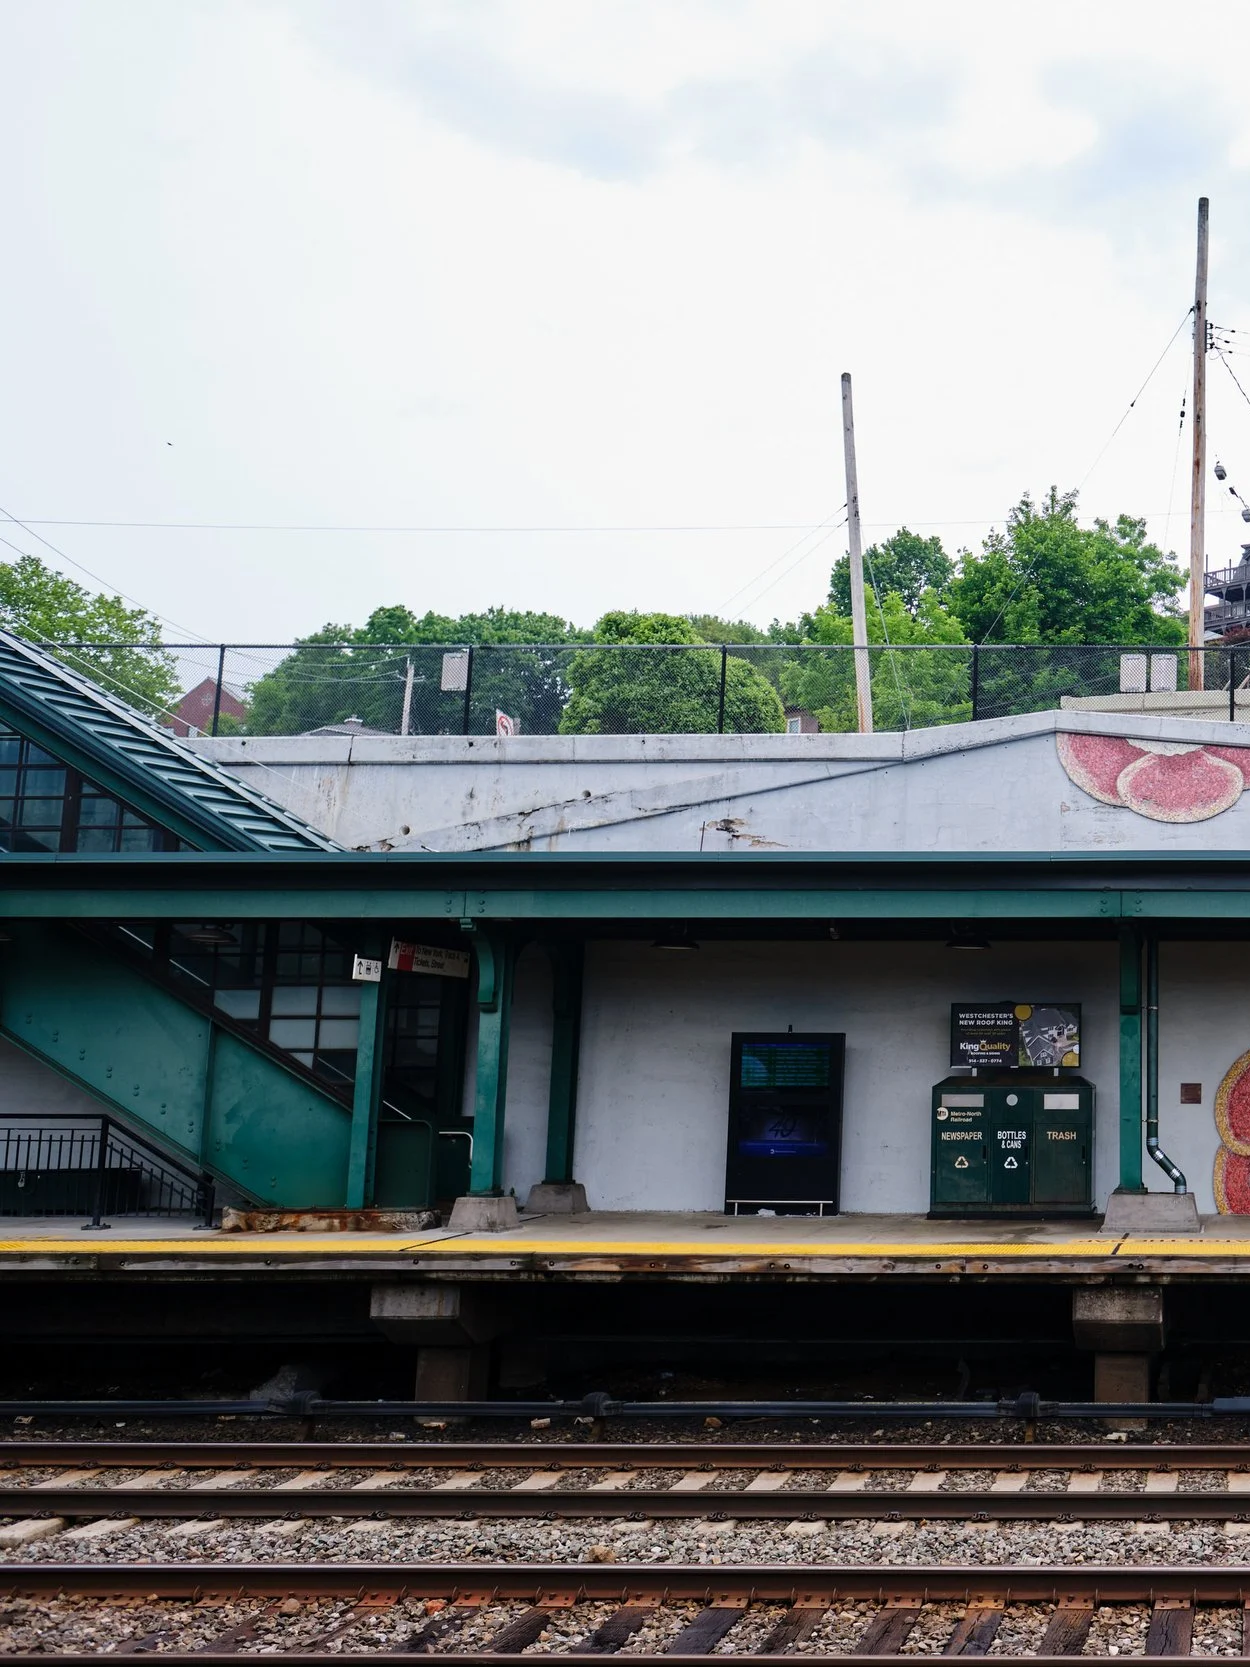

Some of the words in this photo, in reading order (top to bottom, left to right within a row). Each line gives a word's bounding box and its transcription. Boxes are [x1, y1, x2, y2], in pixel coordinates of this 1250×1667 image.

[941, 1131, 983, 1141] NEWSPAPER
[997, 1130, 1027, 1140] BOTTLES
[1046, 1131, 1077, 1141] TRASH
[1001, 1141, 1006, 1149] &
[1006, 1141, 1022, 1149] CANS
